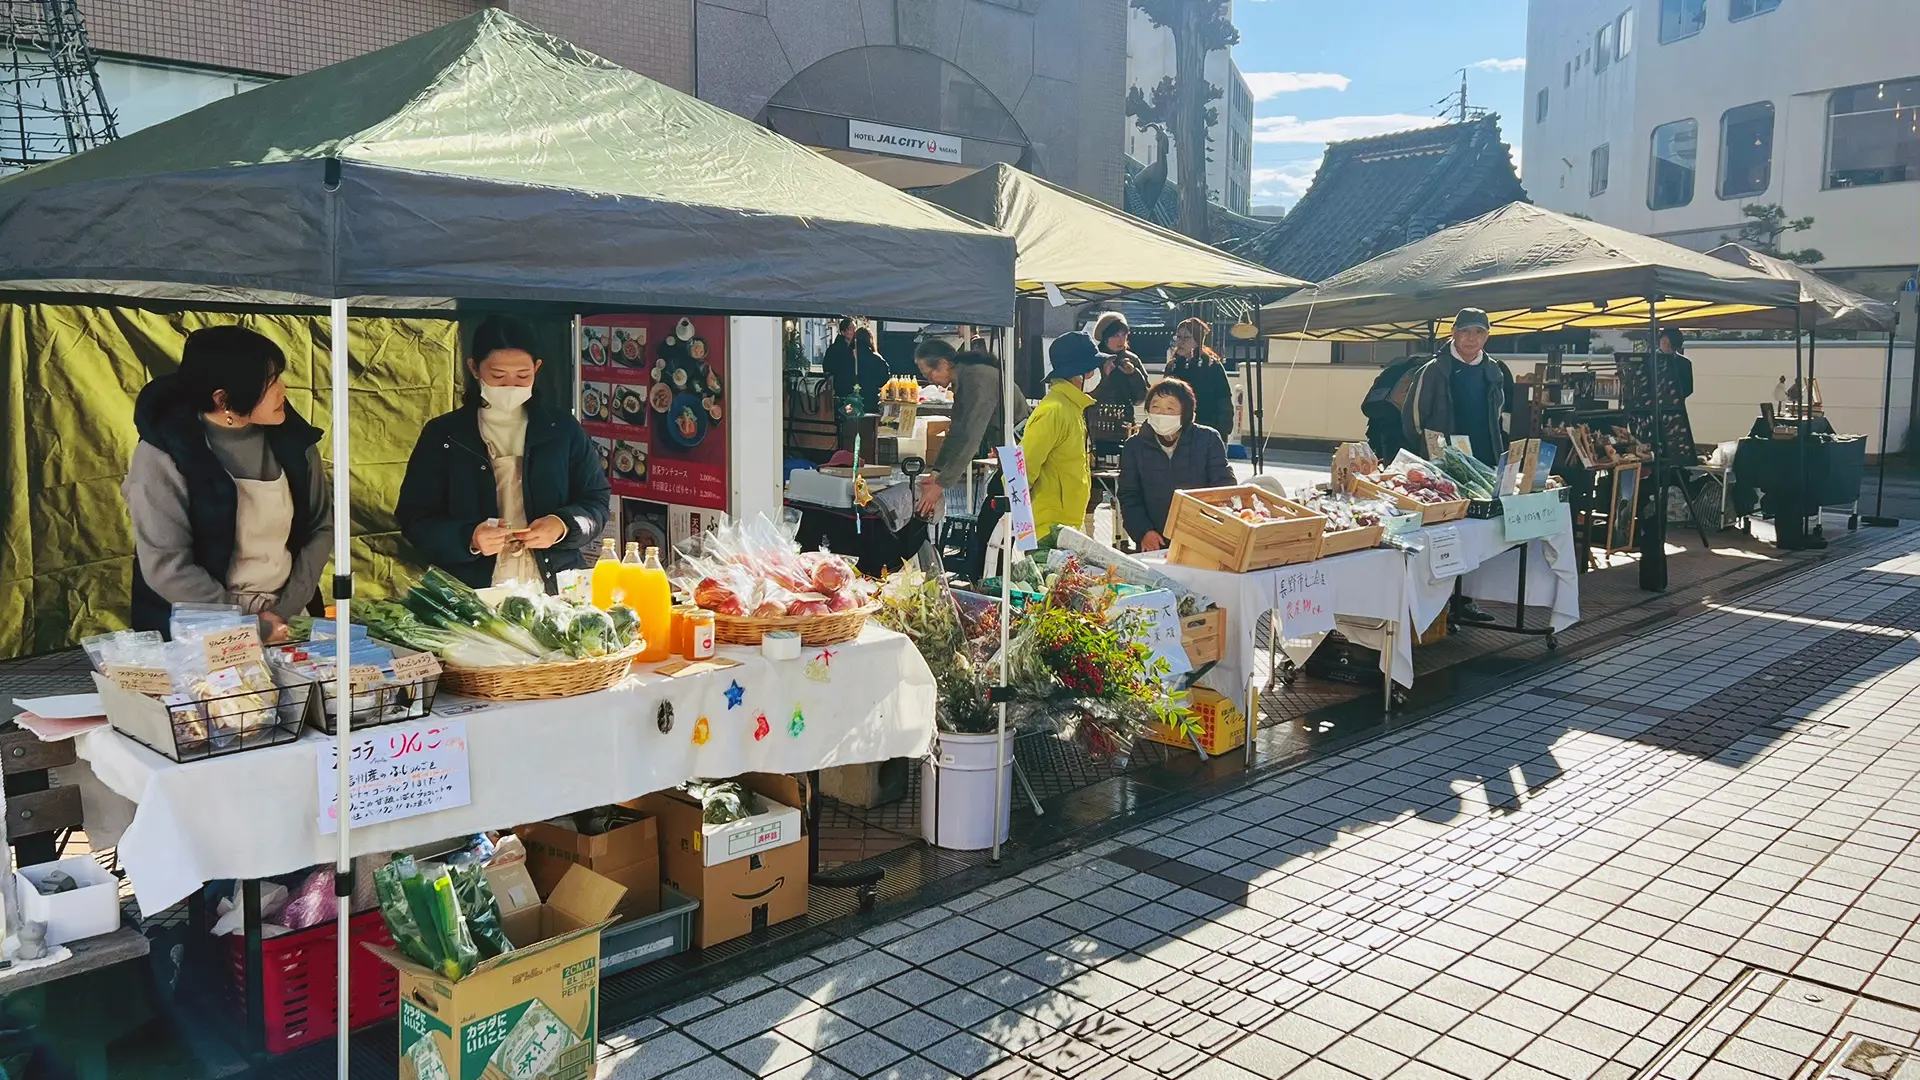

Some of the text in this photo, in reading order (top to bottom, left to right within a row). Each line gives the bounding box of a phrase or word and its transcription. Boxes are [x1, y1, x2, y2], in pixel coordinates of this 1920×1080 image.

[854, 132, 875, 142] HOTEL
[390, 727, 448, 758] りんご
[565, 958, 594, 977] 2CMV1
[467, 1013, 507, 1040] カラダに
[467, 1028, 507, 1053] いいこと
